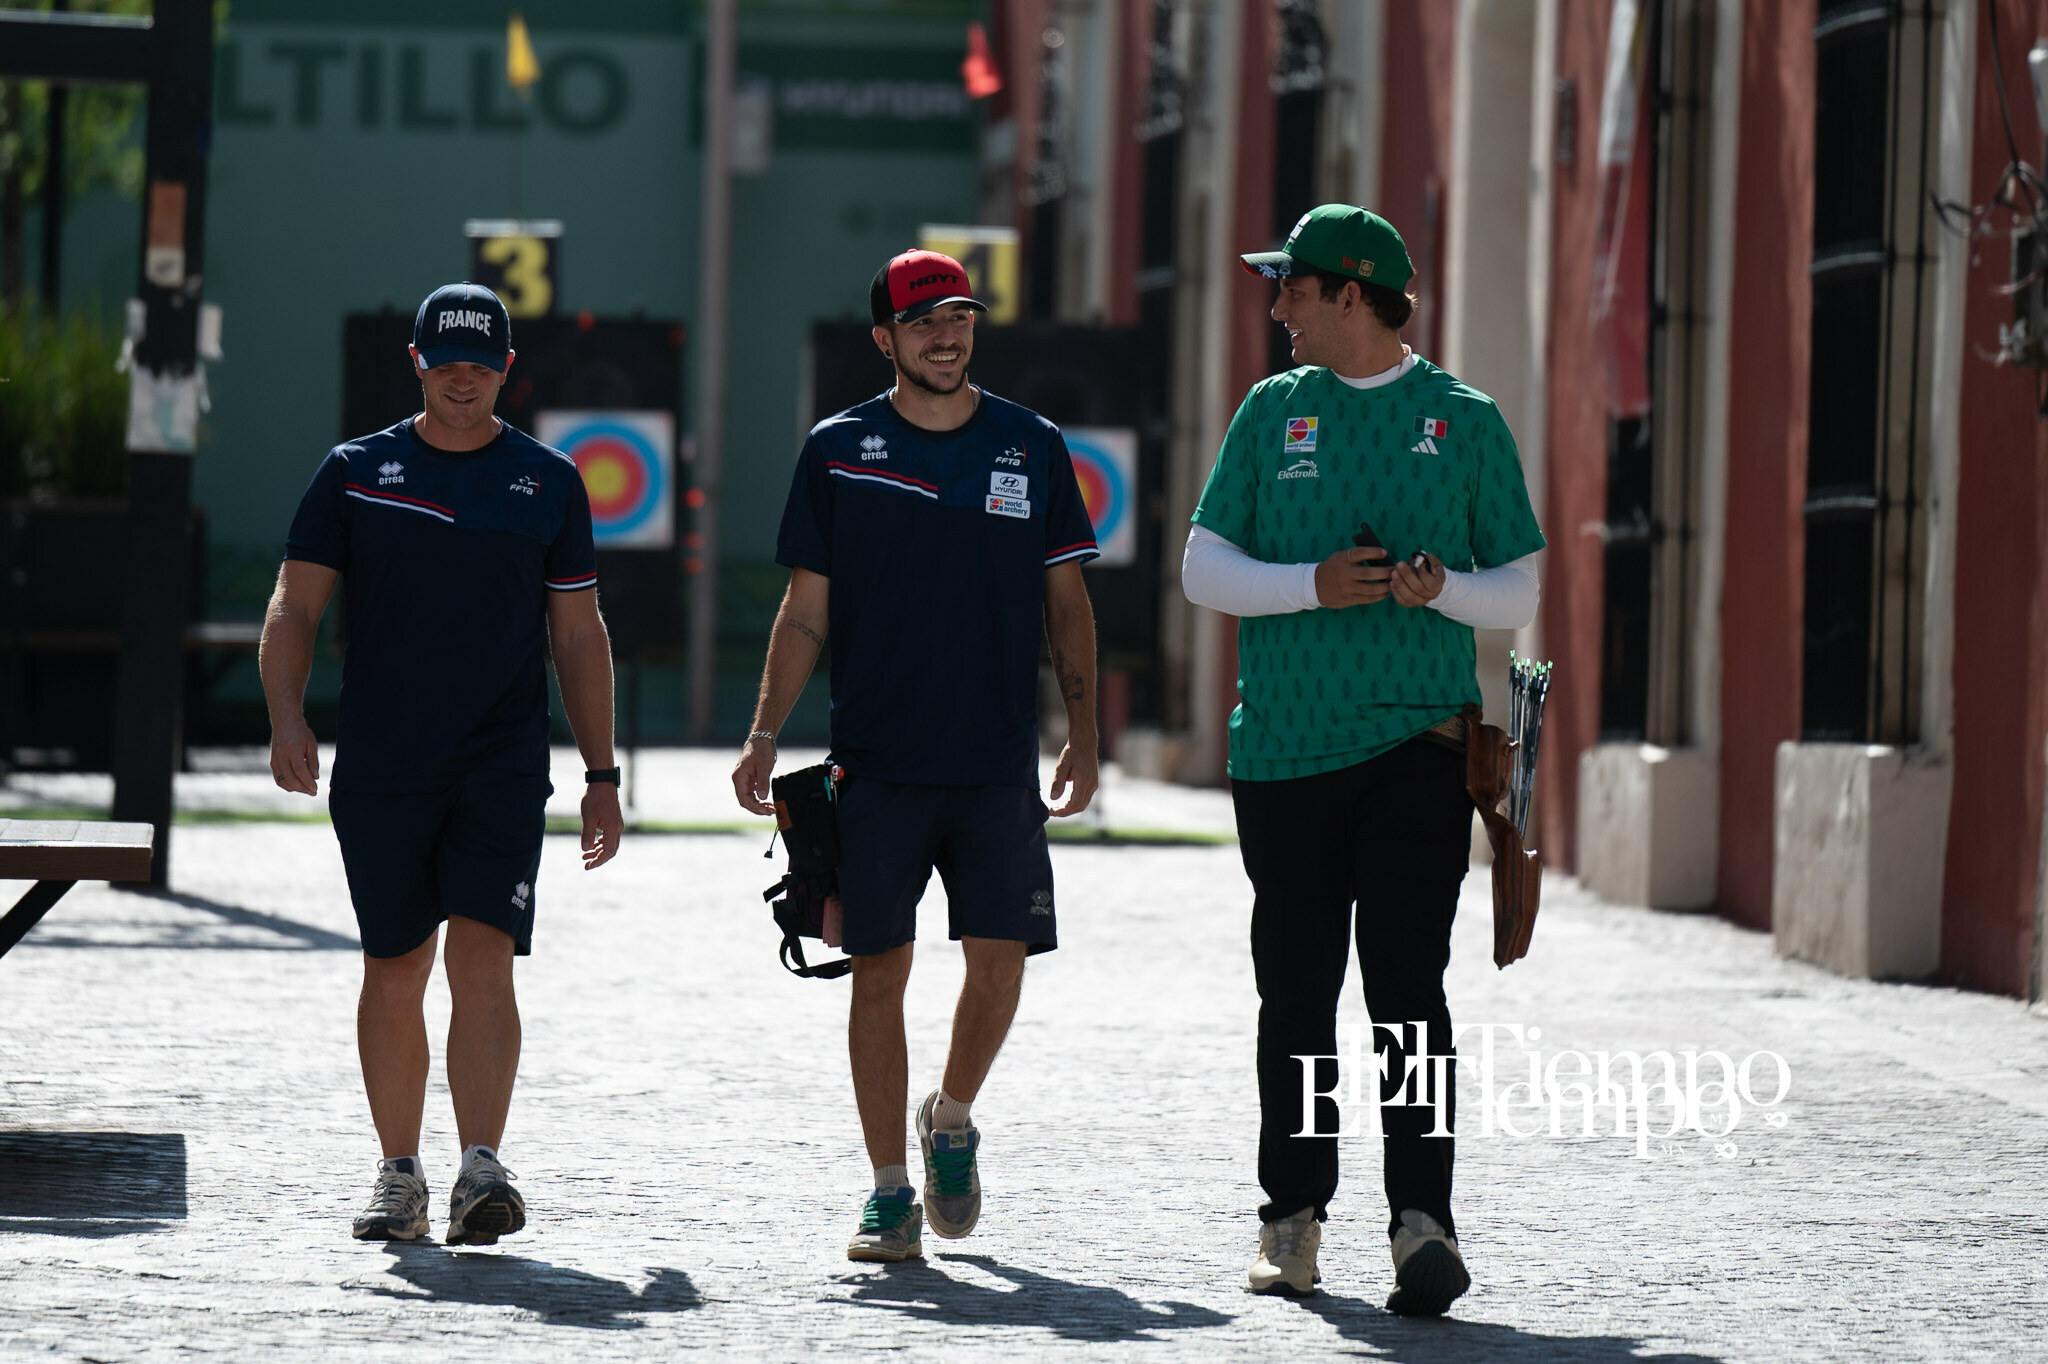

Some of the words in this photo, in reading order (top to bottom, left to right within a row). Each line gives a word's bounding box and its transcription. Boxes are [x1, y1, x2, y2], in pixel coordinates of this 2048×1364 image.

[480, 233, 552, 318] 3
[909, 274, 959, 291] HOYT
[438, 309, 492, 337] FRANCE
[861, 450, 888, 461] errea
[378, 474, 405, 485] errea
[1004, 500, 1023, 509] world
[1003, 505, 1028, 517] archery
